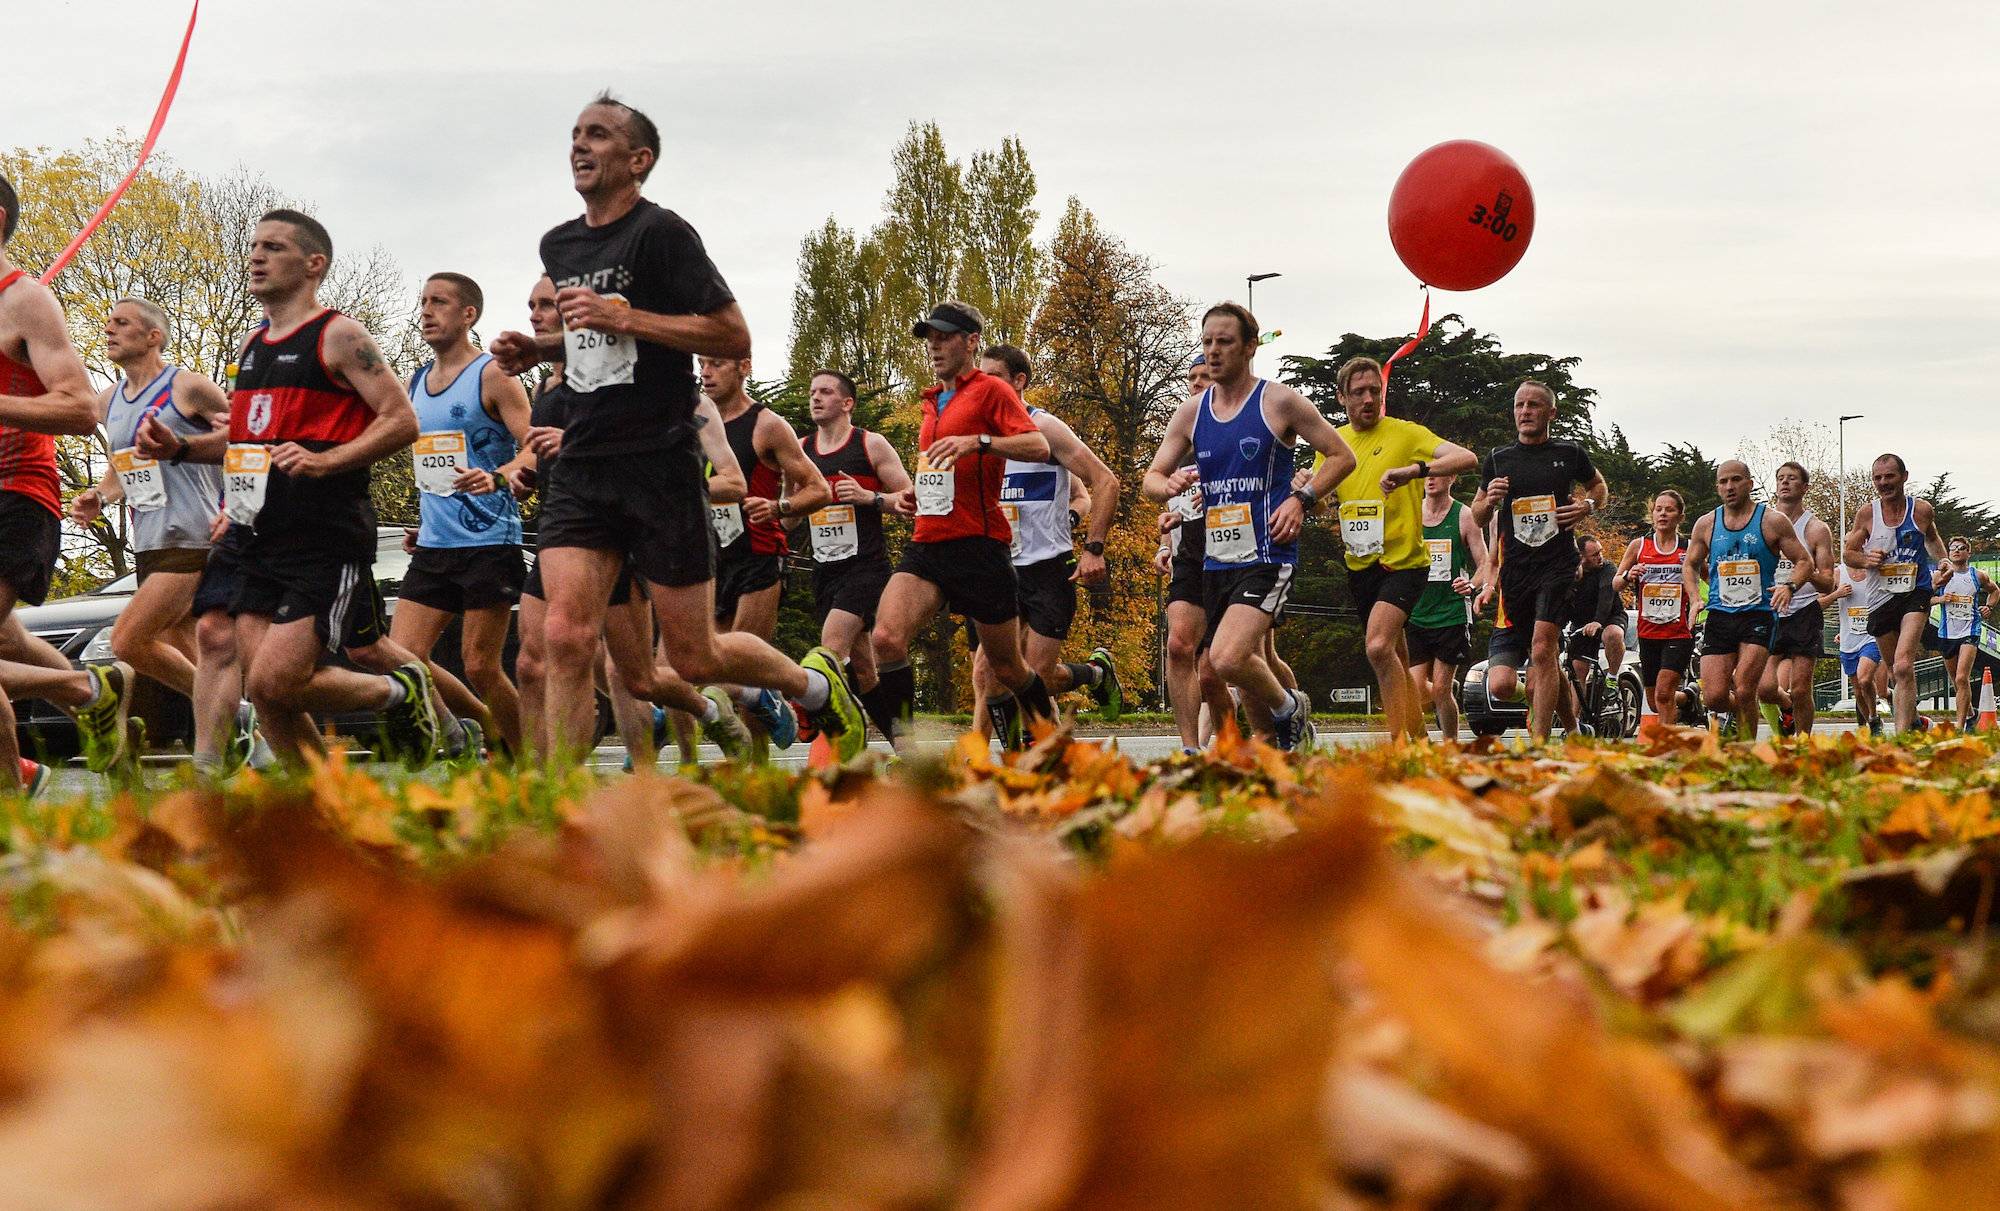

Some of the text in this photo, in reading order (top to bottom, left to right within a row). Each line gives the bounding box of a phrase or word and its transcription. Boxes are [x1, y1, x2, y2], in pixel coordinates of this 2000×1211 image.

[1468, 204, 1517, 241] 3:00
[422, 455, 456, 468] 4203
[1521, 514, 1549, 524] 4543
[819, 526, 844, 537] 2511
[1349, 521, 1370, 532] 203
[1211, 528, 1241, 543] 1395
[1431, 554, 1443, 562] 35
[1725, 577, 1752, 586] 1246
[1887, 577, 1909, 585] 5114
[1649, 599, 1675, 607] 4070
